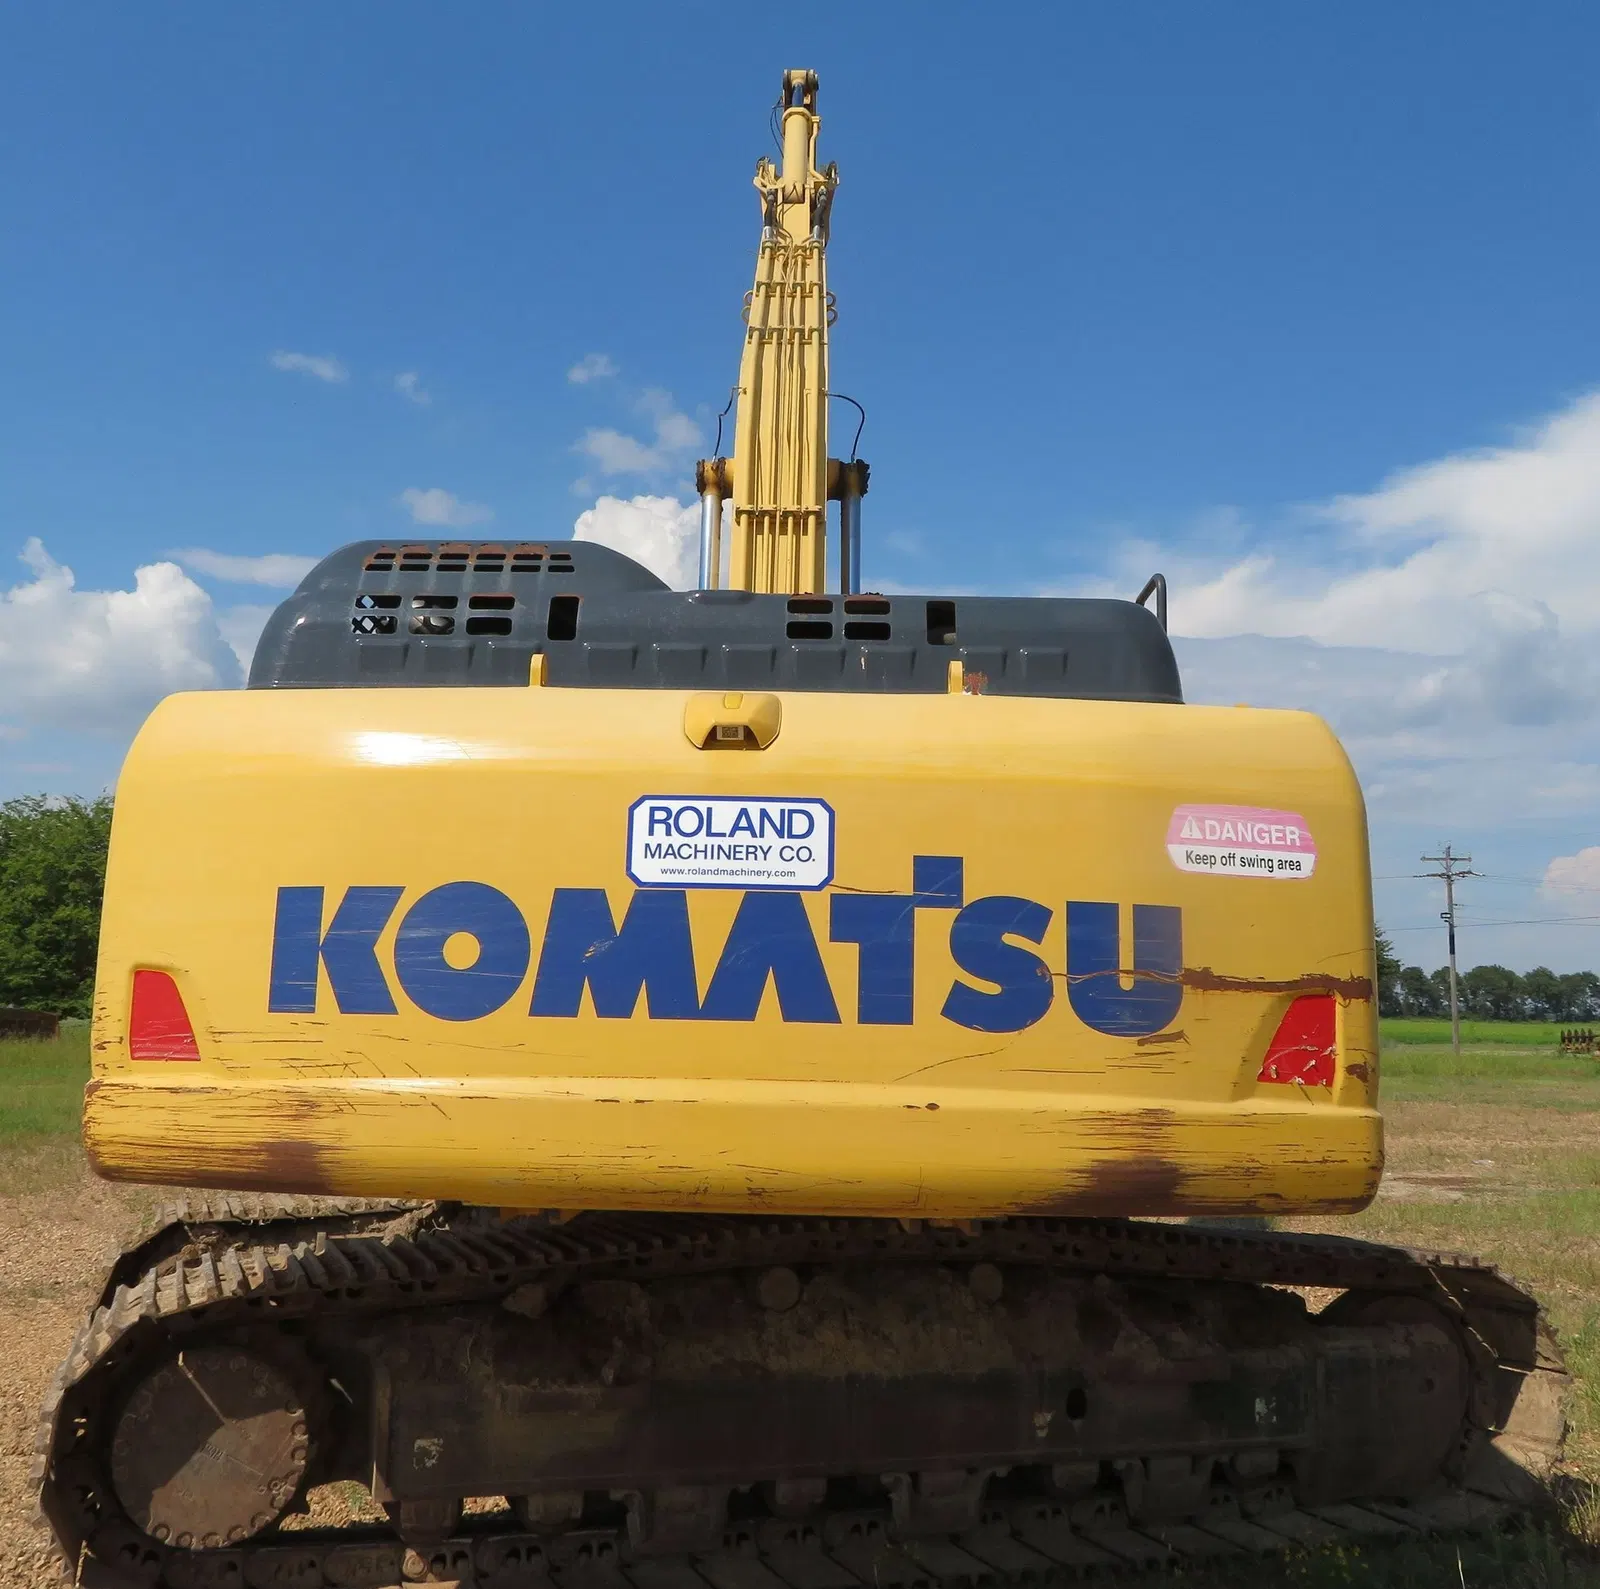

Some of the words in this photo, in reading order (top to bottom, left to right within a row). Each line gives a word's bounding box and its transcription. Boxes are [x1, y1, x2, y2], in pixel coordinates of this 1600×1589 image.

[648, 806, 814, 839] ROLAND
[1205, 820, 1300, 846] DANGER
[643, 843, 772, 860] MACHINERY
[779, 845, 816, 862] CO.
[1185, 850, 1217, 868] Keep
[1220, 852, 1236, 867] off
[1239, 855, 1274, 873] swing
[1277, 860, 1302, 871] area
[660, 867, 796, 878] www.rolandmachinery.com
[267, 856, 1184, 1037] KOMATSU
